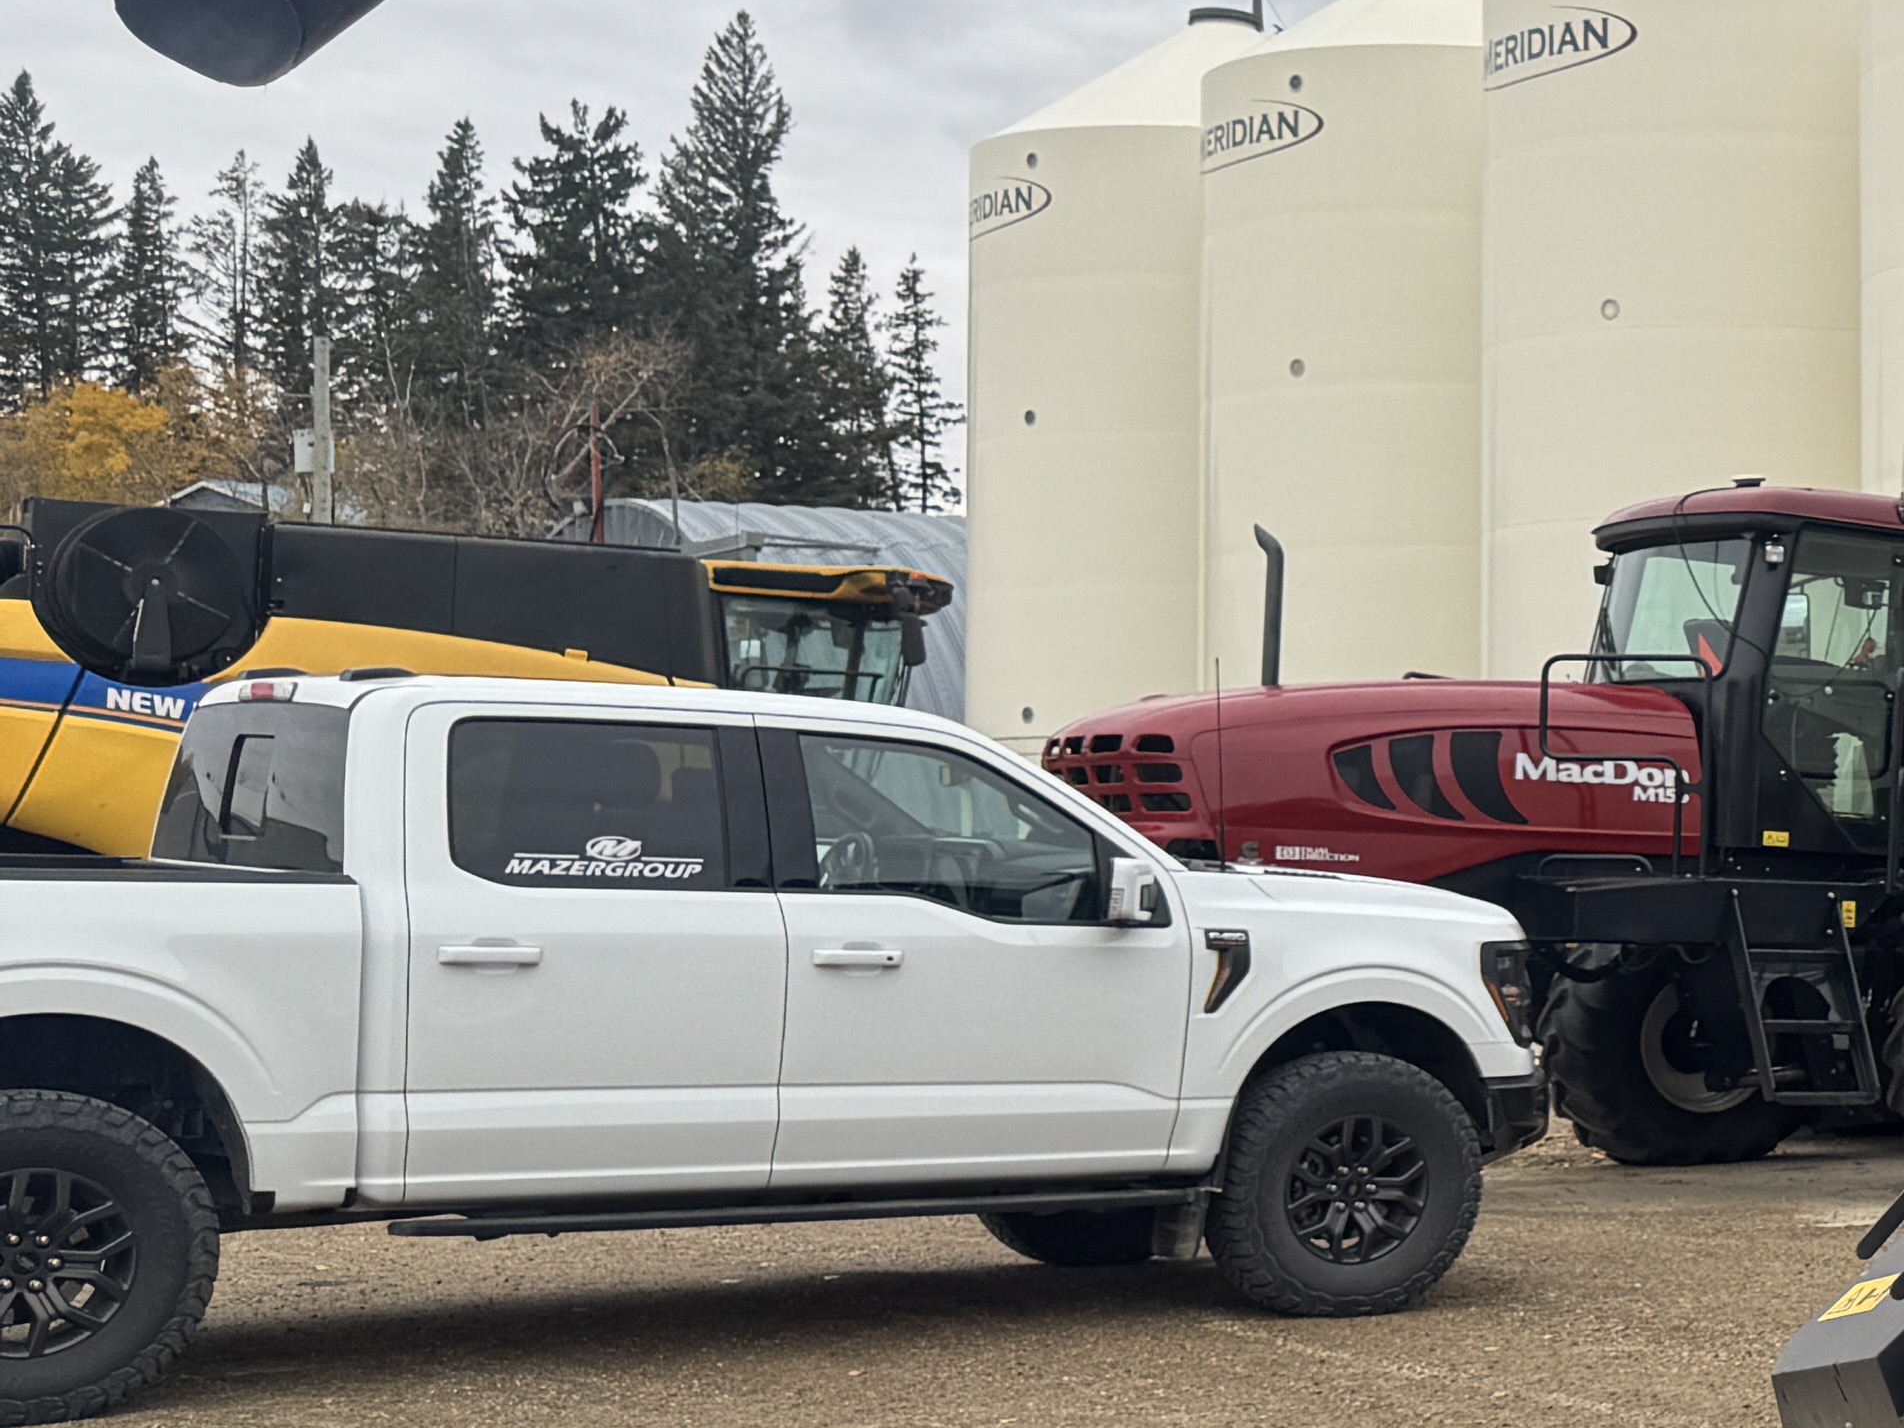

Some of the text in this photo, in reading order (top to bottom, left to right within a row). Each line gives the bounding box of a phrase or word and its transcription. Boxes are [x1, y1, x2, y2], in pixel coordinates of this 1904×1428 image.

[1203, 109, 1299, 158] ERIDIAN
[969, 185, 1032, 225] RIDIAN
[106, 687, 185, 719] NEW
[505, 859, 702, 879] MAZERGROUP
